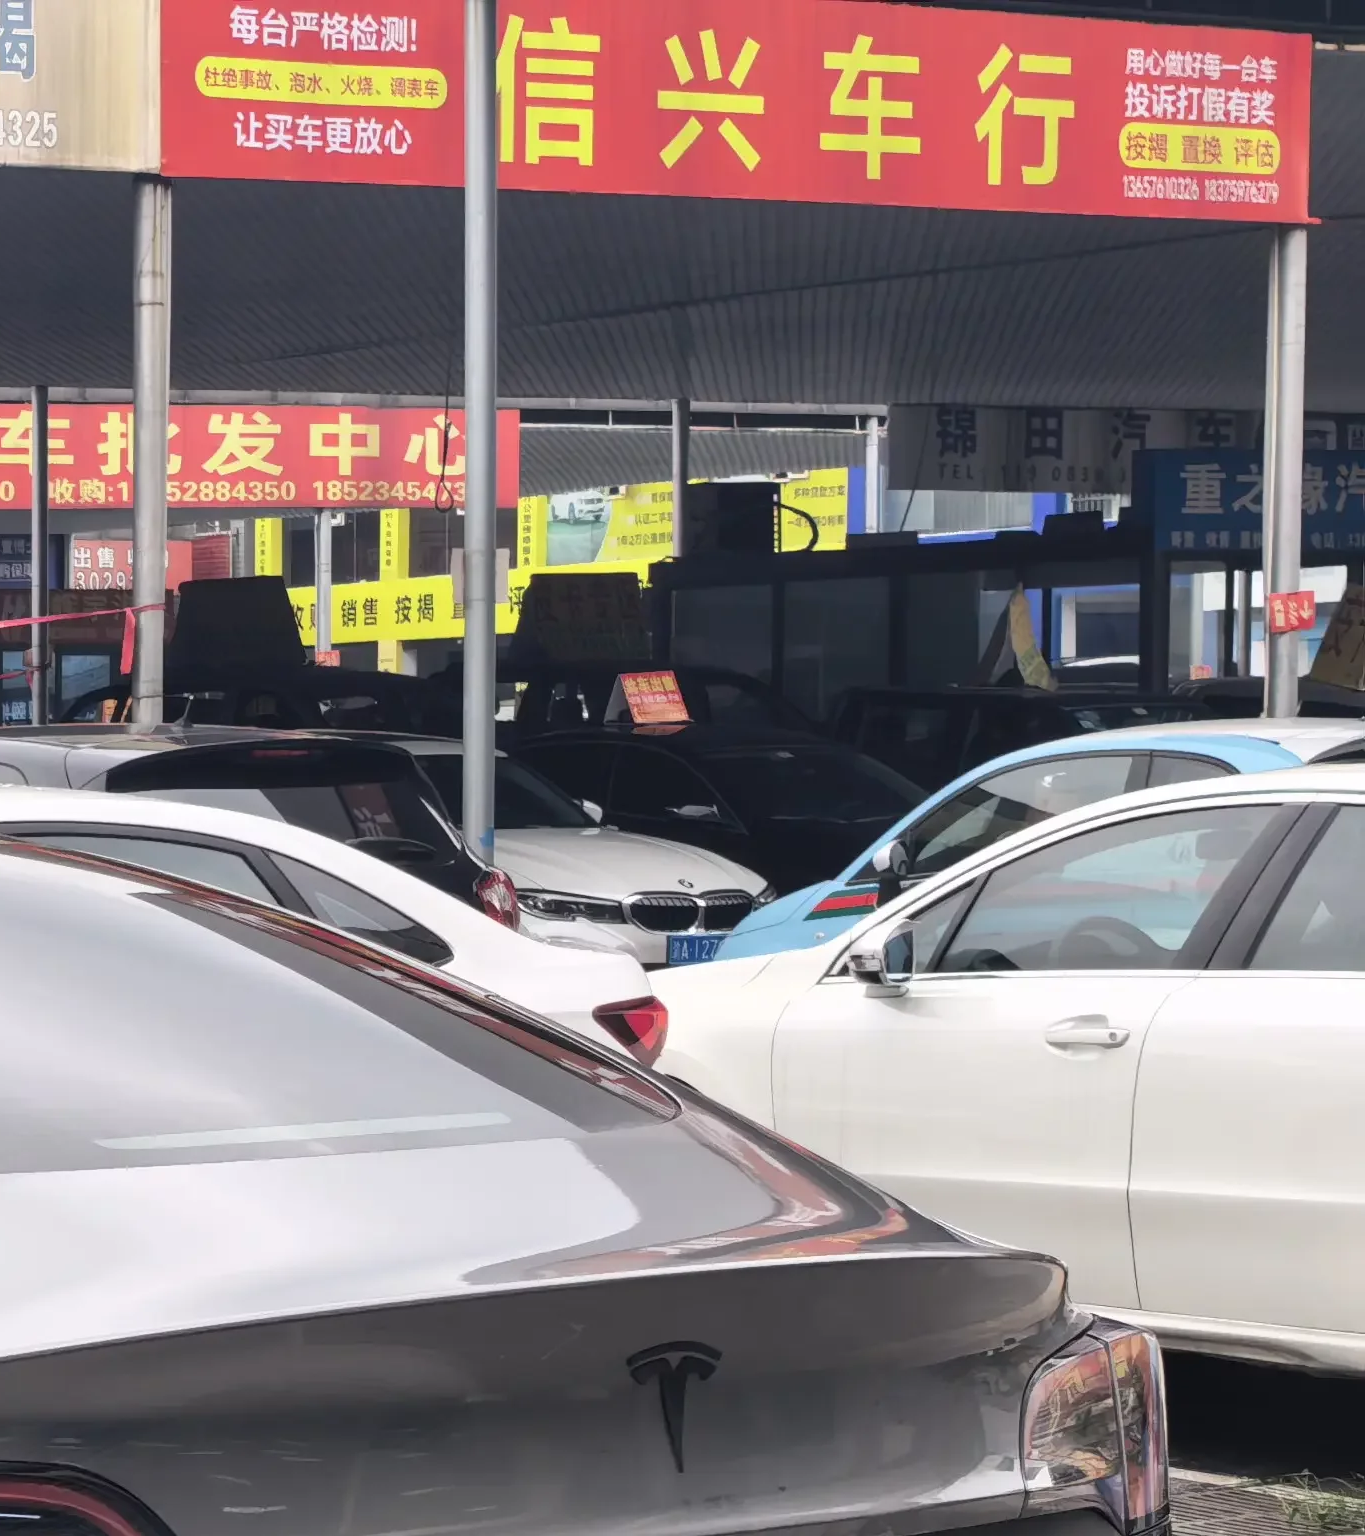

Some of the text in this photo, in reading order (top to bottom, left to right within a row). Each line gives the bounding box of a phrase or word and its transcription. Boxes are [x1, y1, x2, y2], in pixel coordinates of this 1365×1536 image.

[229, 5, 417, 53] 每台严格检测!
[1125, 48, 1277, 83] 用心做好每一台车
[496, 16, 1075, 186] 信兴车行
[1125, 80, 1275, 126] 投诉打假有奖
[233, 111, 412, 155] 让买车更放心
[1126, 131, 1274, 168] 按揭 置换 评估
[48, 478, 296, 506] 收购:152884350
[313, 481, 467, 502] 1852345473
[74, 547, 114, 568] 出售
[341, 598, 379, 627] 销售
[395, 592, 434, 624] 按揭
